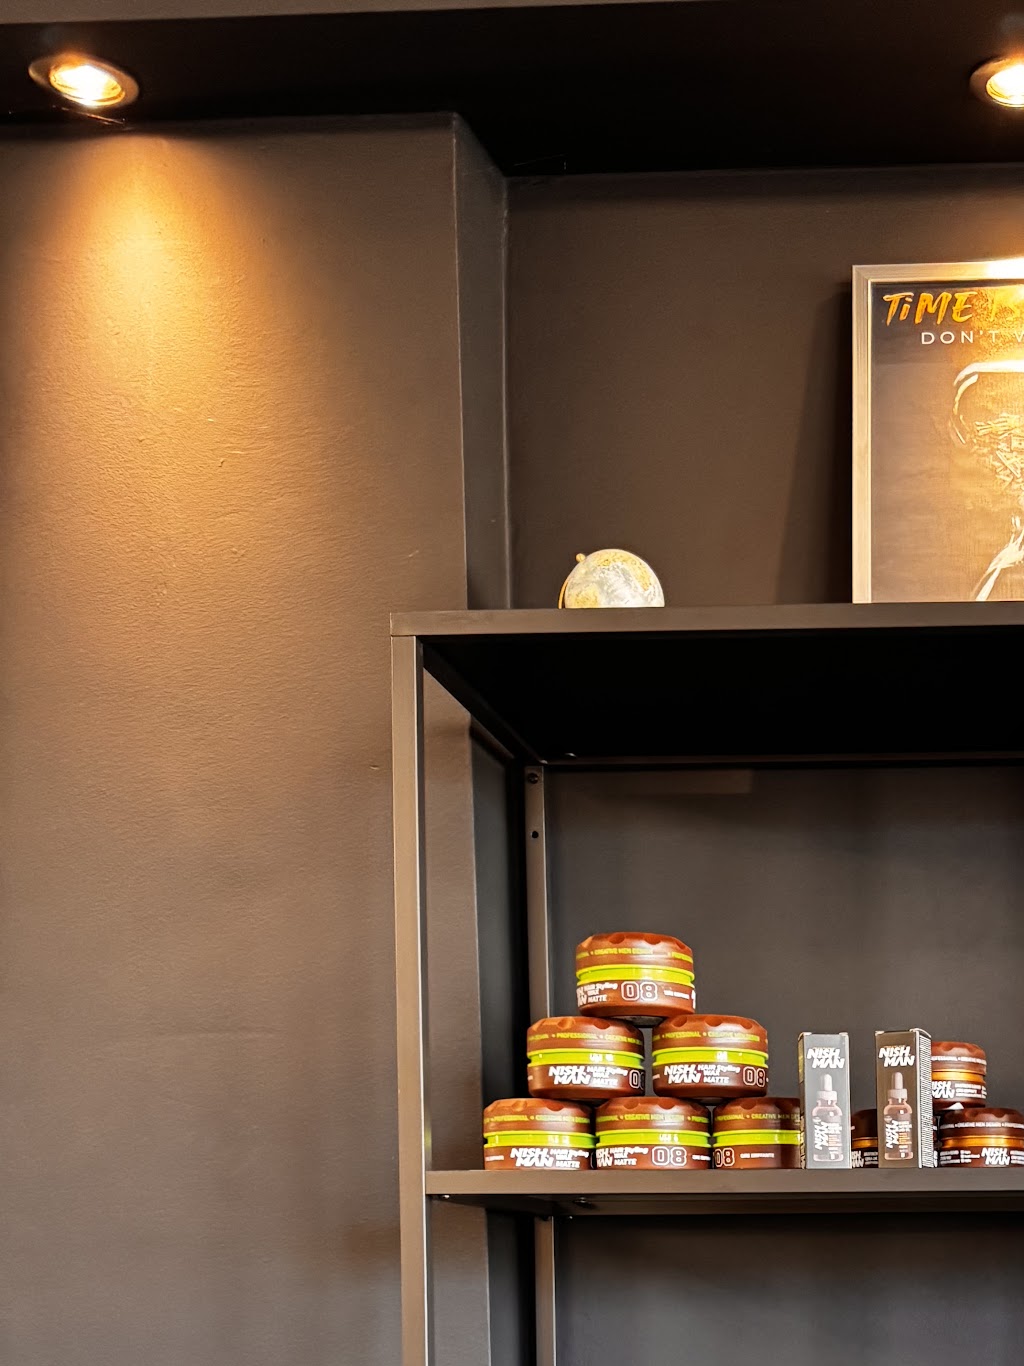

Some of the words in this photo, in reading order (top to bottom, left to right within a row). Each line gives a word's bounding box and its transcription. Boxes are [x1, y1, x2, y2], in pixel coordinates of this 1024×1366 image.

[921, 330, 1000, 345] DON'T
[621, 981, 657, 1001] 08
[812, 1058, 845, 1068] MAN
[884, 1056, 915, 1067] MAN
[743, 1066, 765, 1087] 08
[652, 1146, 687, 1166] 08
[714, 1148, 735, 1167] 08
